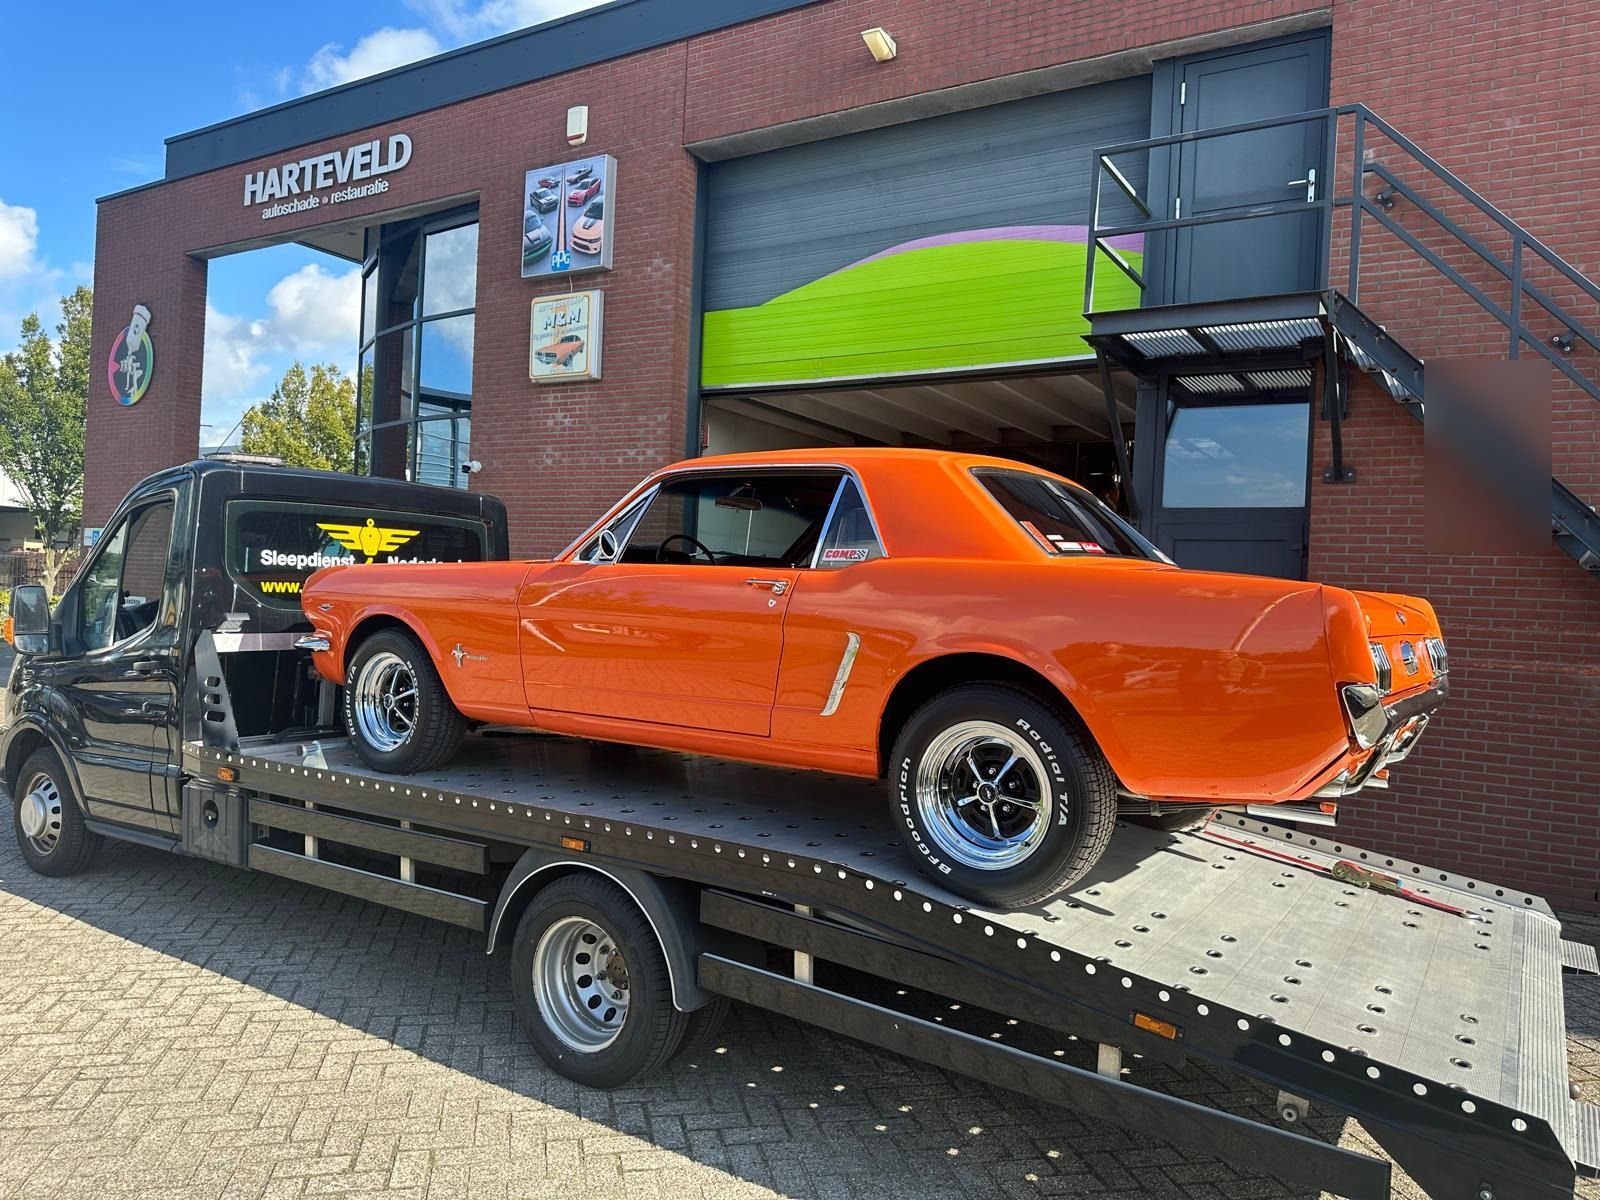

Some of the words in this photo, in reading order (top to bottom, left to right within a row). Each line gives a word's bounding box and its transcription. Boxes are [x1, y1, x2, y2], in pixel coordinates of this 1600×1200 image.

[243, 133, 413, 206] HARTEVELD
[261, 194, 320, 220] autoschade
[330, 178, 390, 205] restauratie
[551, 250, 570, 268] PPG
[543, 308, 582, 331] M&M
[260, 549, 355, 570] Sleepdienst
[825, 549, 857, 559] COMP
[345, 690, 357, 736] Radial
[1015, 718, 1065, 783] Radial
[1057, 791, 1069, 826] T/A
[898, 757, 952, 875] BFGoodrich
